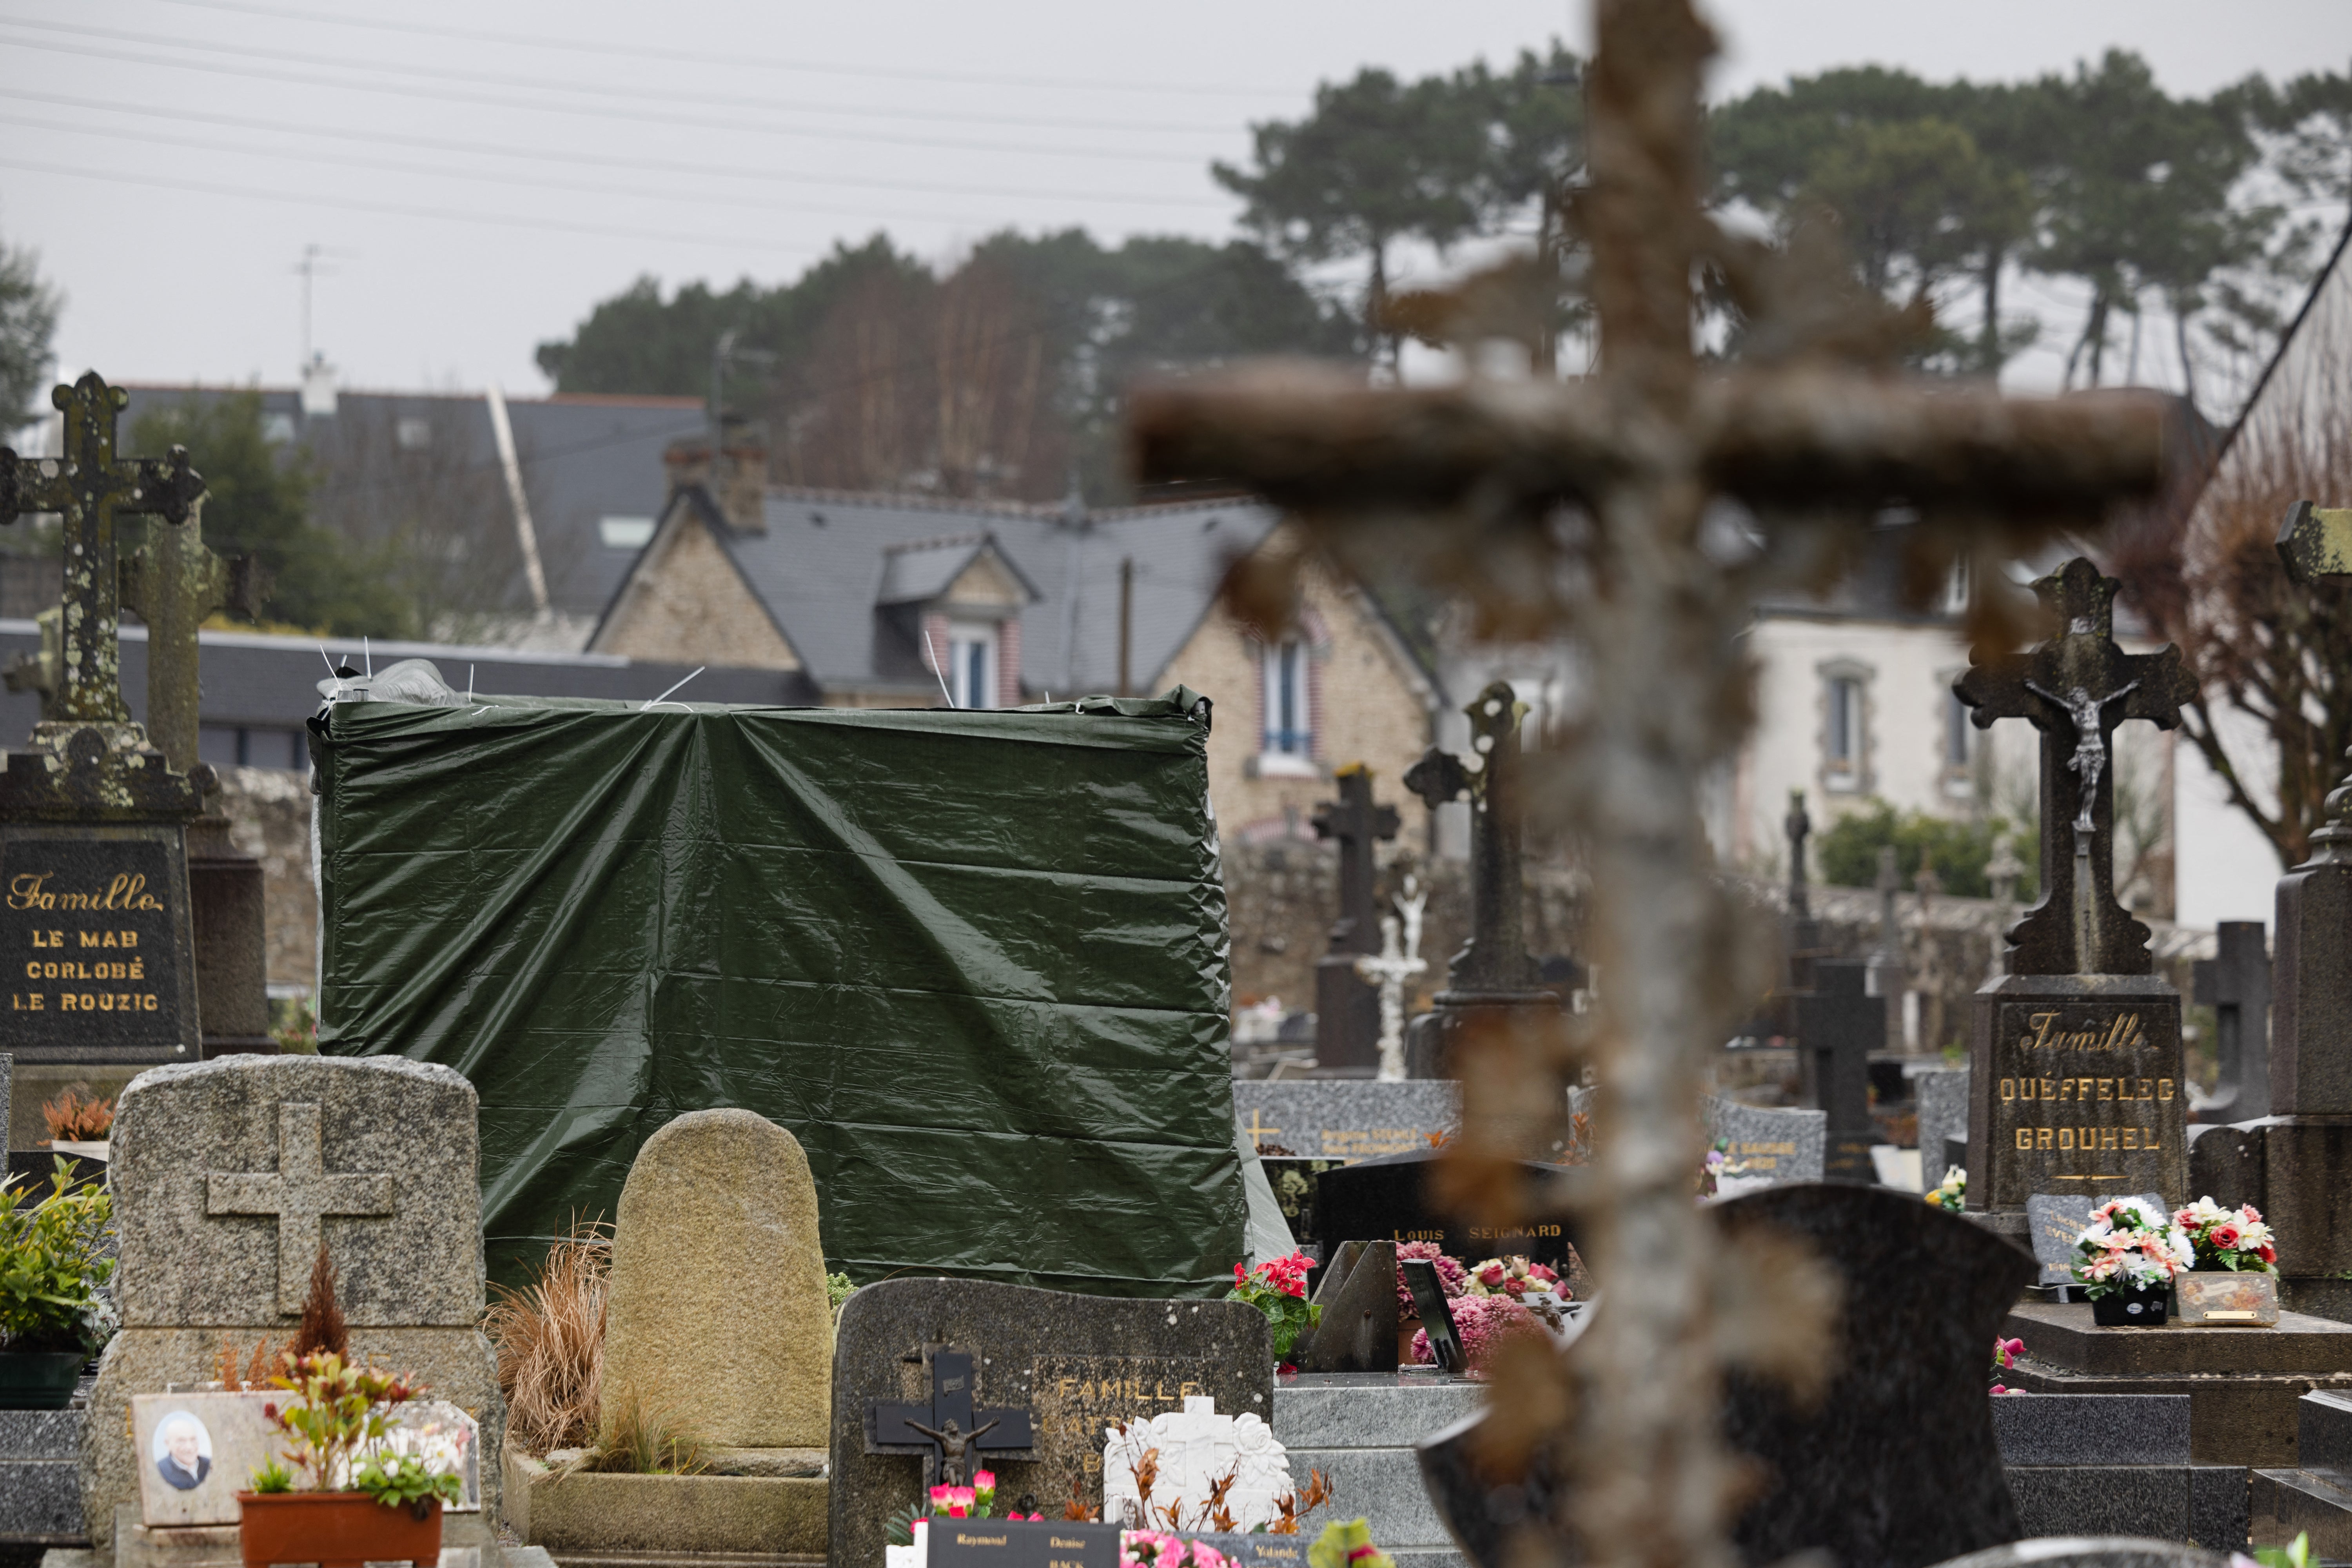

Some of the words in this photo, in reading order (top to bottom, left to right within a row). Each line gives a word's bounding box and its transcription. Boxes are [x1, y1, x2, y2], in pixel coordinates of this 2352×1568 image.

[7, 870, 165, 911] Famille
[33, 930, 64, 947] LE
[80, 930, 138, 947] MAB
[27, 956, 145, 980] CORLOBÉ
[13, 993, 44, 1011] LE
[61, 993, 158, 1011] ROUZIC
[2000, 1071, 2175, 1106] QUÉFFELEC
[2016, 1127, 2160, 1150] GROUHEL
[1469, 1225, 1561, 1239] SEIGNARD
[1060, 1378, 1198, 1400] FAMILLE
[957, 1533, 1007, 1548] Raymond
[1050, 1536, 1086, 1549] Denise
[1256, 1544, 1298, 1559] Yolande
